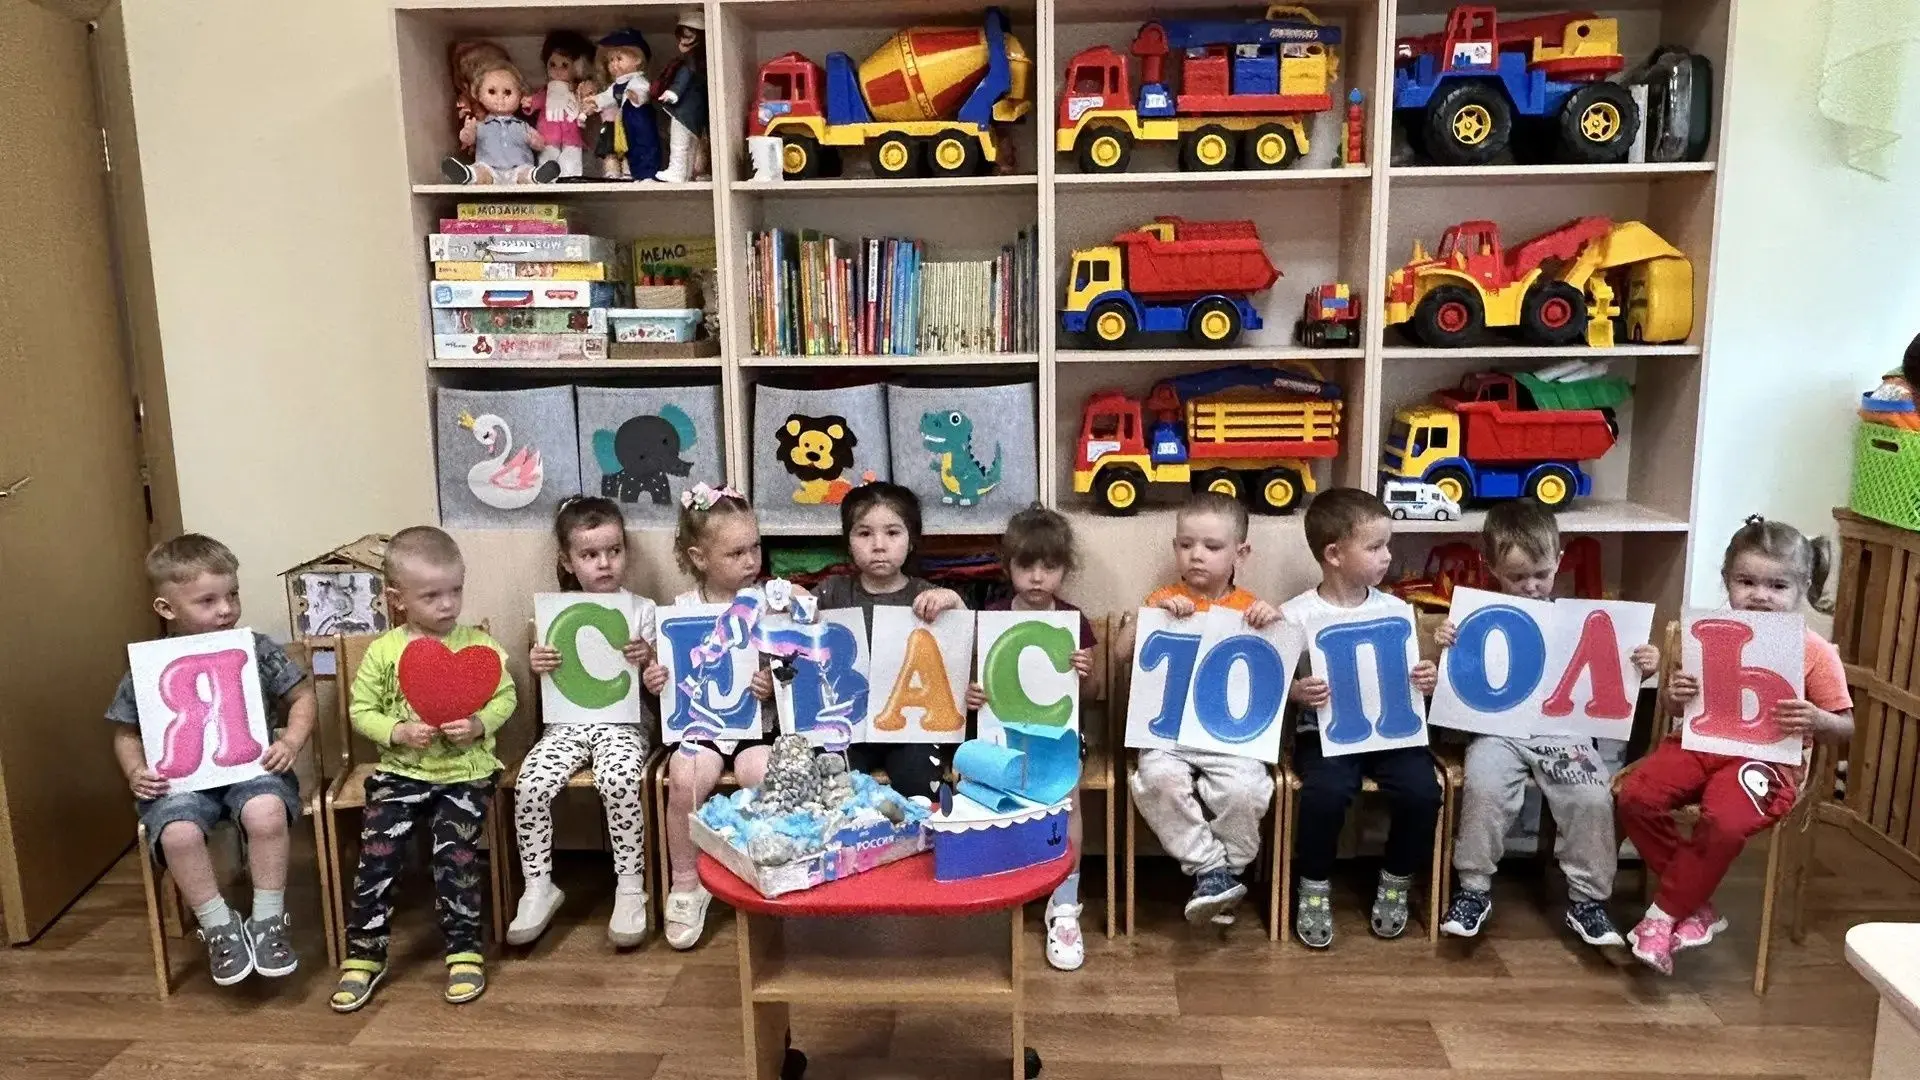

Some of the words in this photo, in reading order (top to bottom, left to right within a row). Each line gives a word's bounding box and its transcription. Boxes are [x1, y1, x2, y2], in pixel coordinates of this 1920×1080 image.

[157, 649, 262, 778] Я
[873, 627, 965, 731] А
[1315, 616, 1422, 744] П
